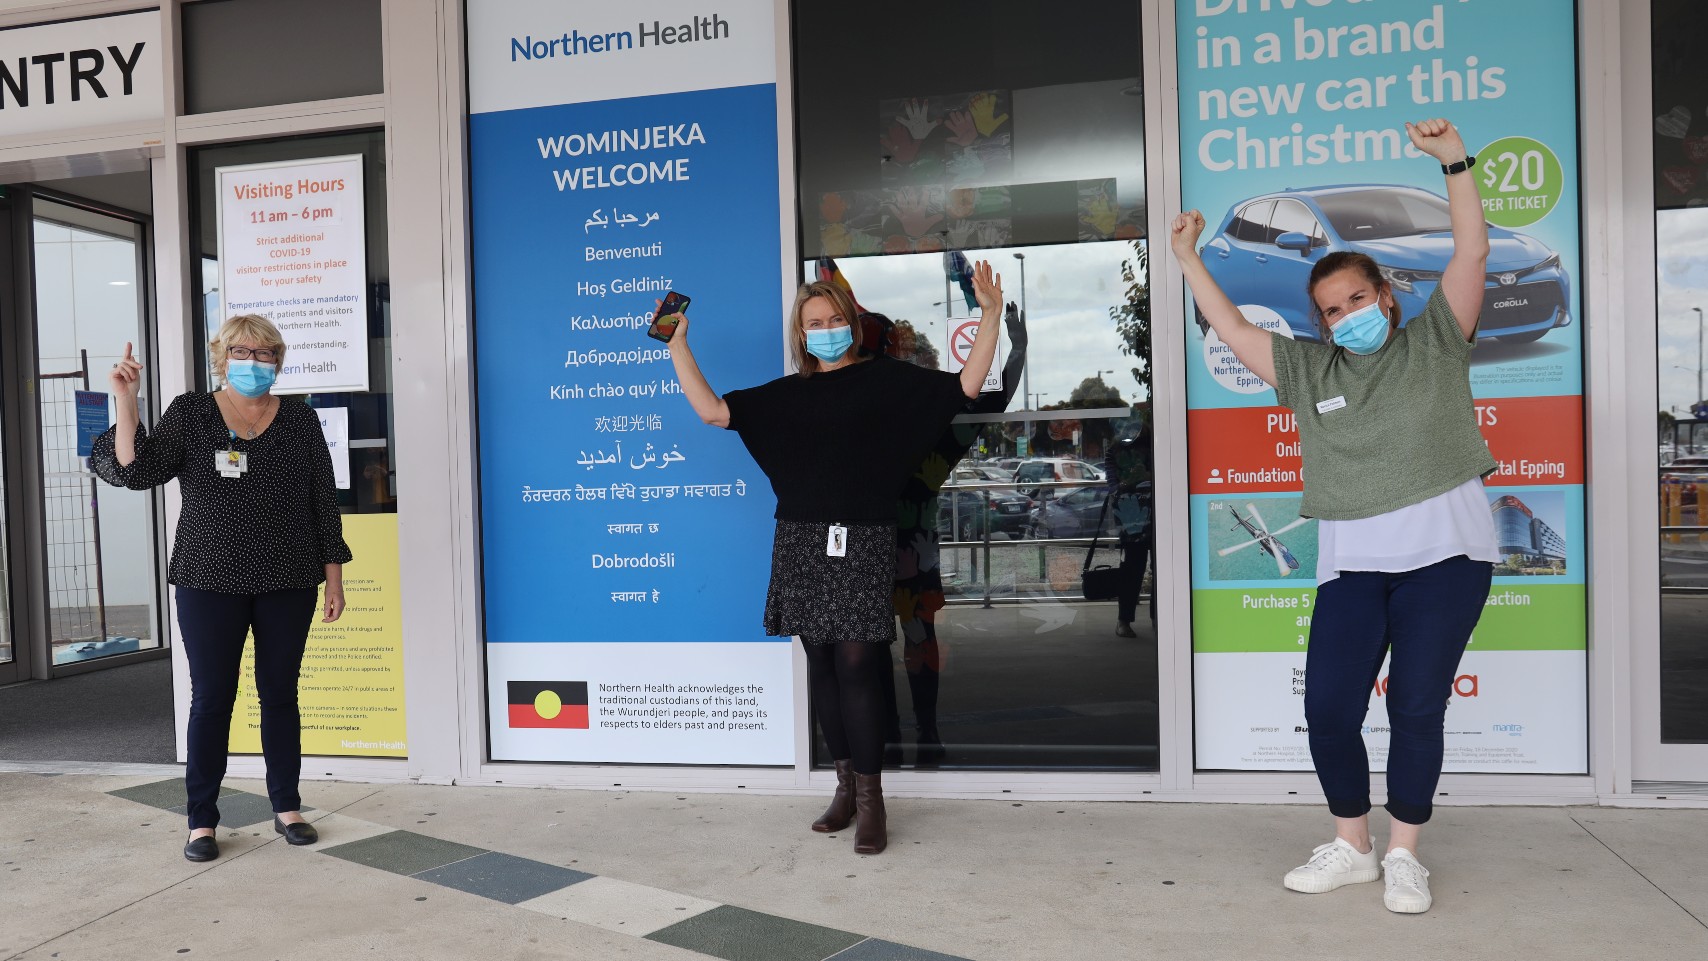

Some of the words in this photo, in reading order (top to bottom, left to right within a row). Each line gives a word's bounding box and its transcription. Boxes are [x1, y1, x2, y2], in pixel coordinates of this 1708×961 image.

[511, 29, 633, 62] Northern
[638, 13, 729, 48] Health
[1196, 27, 1242, 69] in
[1253, 32, 1282, 64] a
[1294, 4, 1445, 61] brand
[0, 42, 146, 110] NTRY
[1198, 82, 1306, 121] new
[1316, 74, 1397, 112] car
[1407, 55, 1507, 105] this
[536, 122, 707, 159] WOMINJEKA
[552, 158, 691, 192] WELCOME
[1483, 150, 1545, 193] $20
[234, 182, 293, 200] Visiting
[298, 178, 345, 195] Hours
[1481, 198, 1504, 212] PER
[1507, 195, 1548, 210] TICKET
[250, 210, 266, 224] 11
[268, 211, 288, 222] am
[301, 207, 310, 220] 6
[312, 207, 333, 221] pm
[584, 208, 609, 234] بكم
[613, 208, 660, 228] مرحبا
[256, 236, 278, 246] Strict
[280, 232, 324, 244] additional
[270, 247, 311, 258] COVID-19
[585, 241, 662, 261] Benvenuti
[236, 264, 262, 275] visitor
[264, 261, 312, 272] restrictions
[313, 260, 322, 269] in
[324, 259, 347, 270] place
[261, 277, 272, 287] for
[275, 277, 294, 288] your
[296, 275, 322, 286] safety
[577, 281, 607, 297] Hoş
[610, 275, 673, 294] Geldiniz
[228, 300, 274, 310] Temperature
[276, 297, 301, 306] checks
[316, 294, 359, 304] mandatory
[1493, 298, 1528, 309] COROLLA
[277, 310, 307, 319] patients
[308, 308, 323, 317] and
[325, 307, 353, 316] visitors
[571, 311, 655, 331] Καλωσήρθ
[278, 322, 312, 331] Northern
[1256, 319, 1280, 329] raised
[564, 347, 671, 368] Добродојдов
[302, 361, 337, 374] Health
[550, 384, 584, 400] Kính
[588, 382, 625, 398] chào
[628, 380, 658, 398] quý
[1236, 377, 1264, 388] Epping
[594, 413, 662, 433] 欢迎光临
[630, 442, 686, 470] خوش
[1276, 442, 1302, 457] Onli
[1227, 467, 1296, 483] Foundation
[1520, 460, 1565, 479] Epping
[1210, 502, 1223, 510] 2nd
[592, 552, 675, 569] Dobrodošli
[1243, 594, 1298, 609] Purchase
[1302, 594, 1310, 608] 5
[1484, 591, 1531, 606] saction
[599, 683, 642, 693] Northern
[644, 683, 675, 693] Health
[677, 684, 745, 695] acknowledges
[747, 684, 764, 694] the
[599, 695, 647, 704] traditional
[650, 695, 700, 705] custodians
[702, 696, 713, 705] of
[715, 696, 733, 706] this
[735, 696, 759, 707] land,
[599, 707, 615, 716] the
[618, 707, 671, 719] Wurundjeri
[673, 708, 709, 719] people,
[711, 708, 729, 718] and
[732, 709, 754, 720] pays
[756, 709, 768, 718] its
[600, 720, 639, 730] respects
[641, 720, 651, 729] to
[653, 720, 682, 729] elders
[684, 721, 705, 731] past
[707, 720, 725, 730] and
[728, 721, 768, 731] present.
[341, 740, 378, 749] Northern
[379, 740, 406, 750] Health
